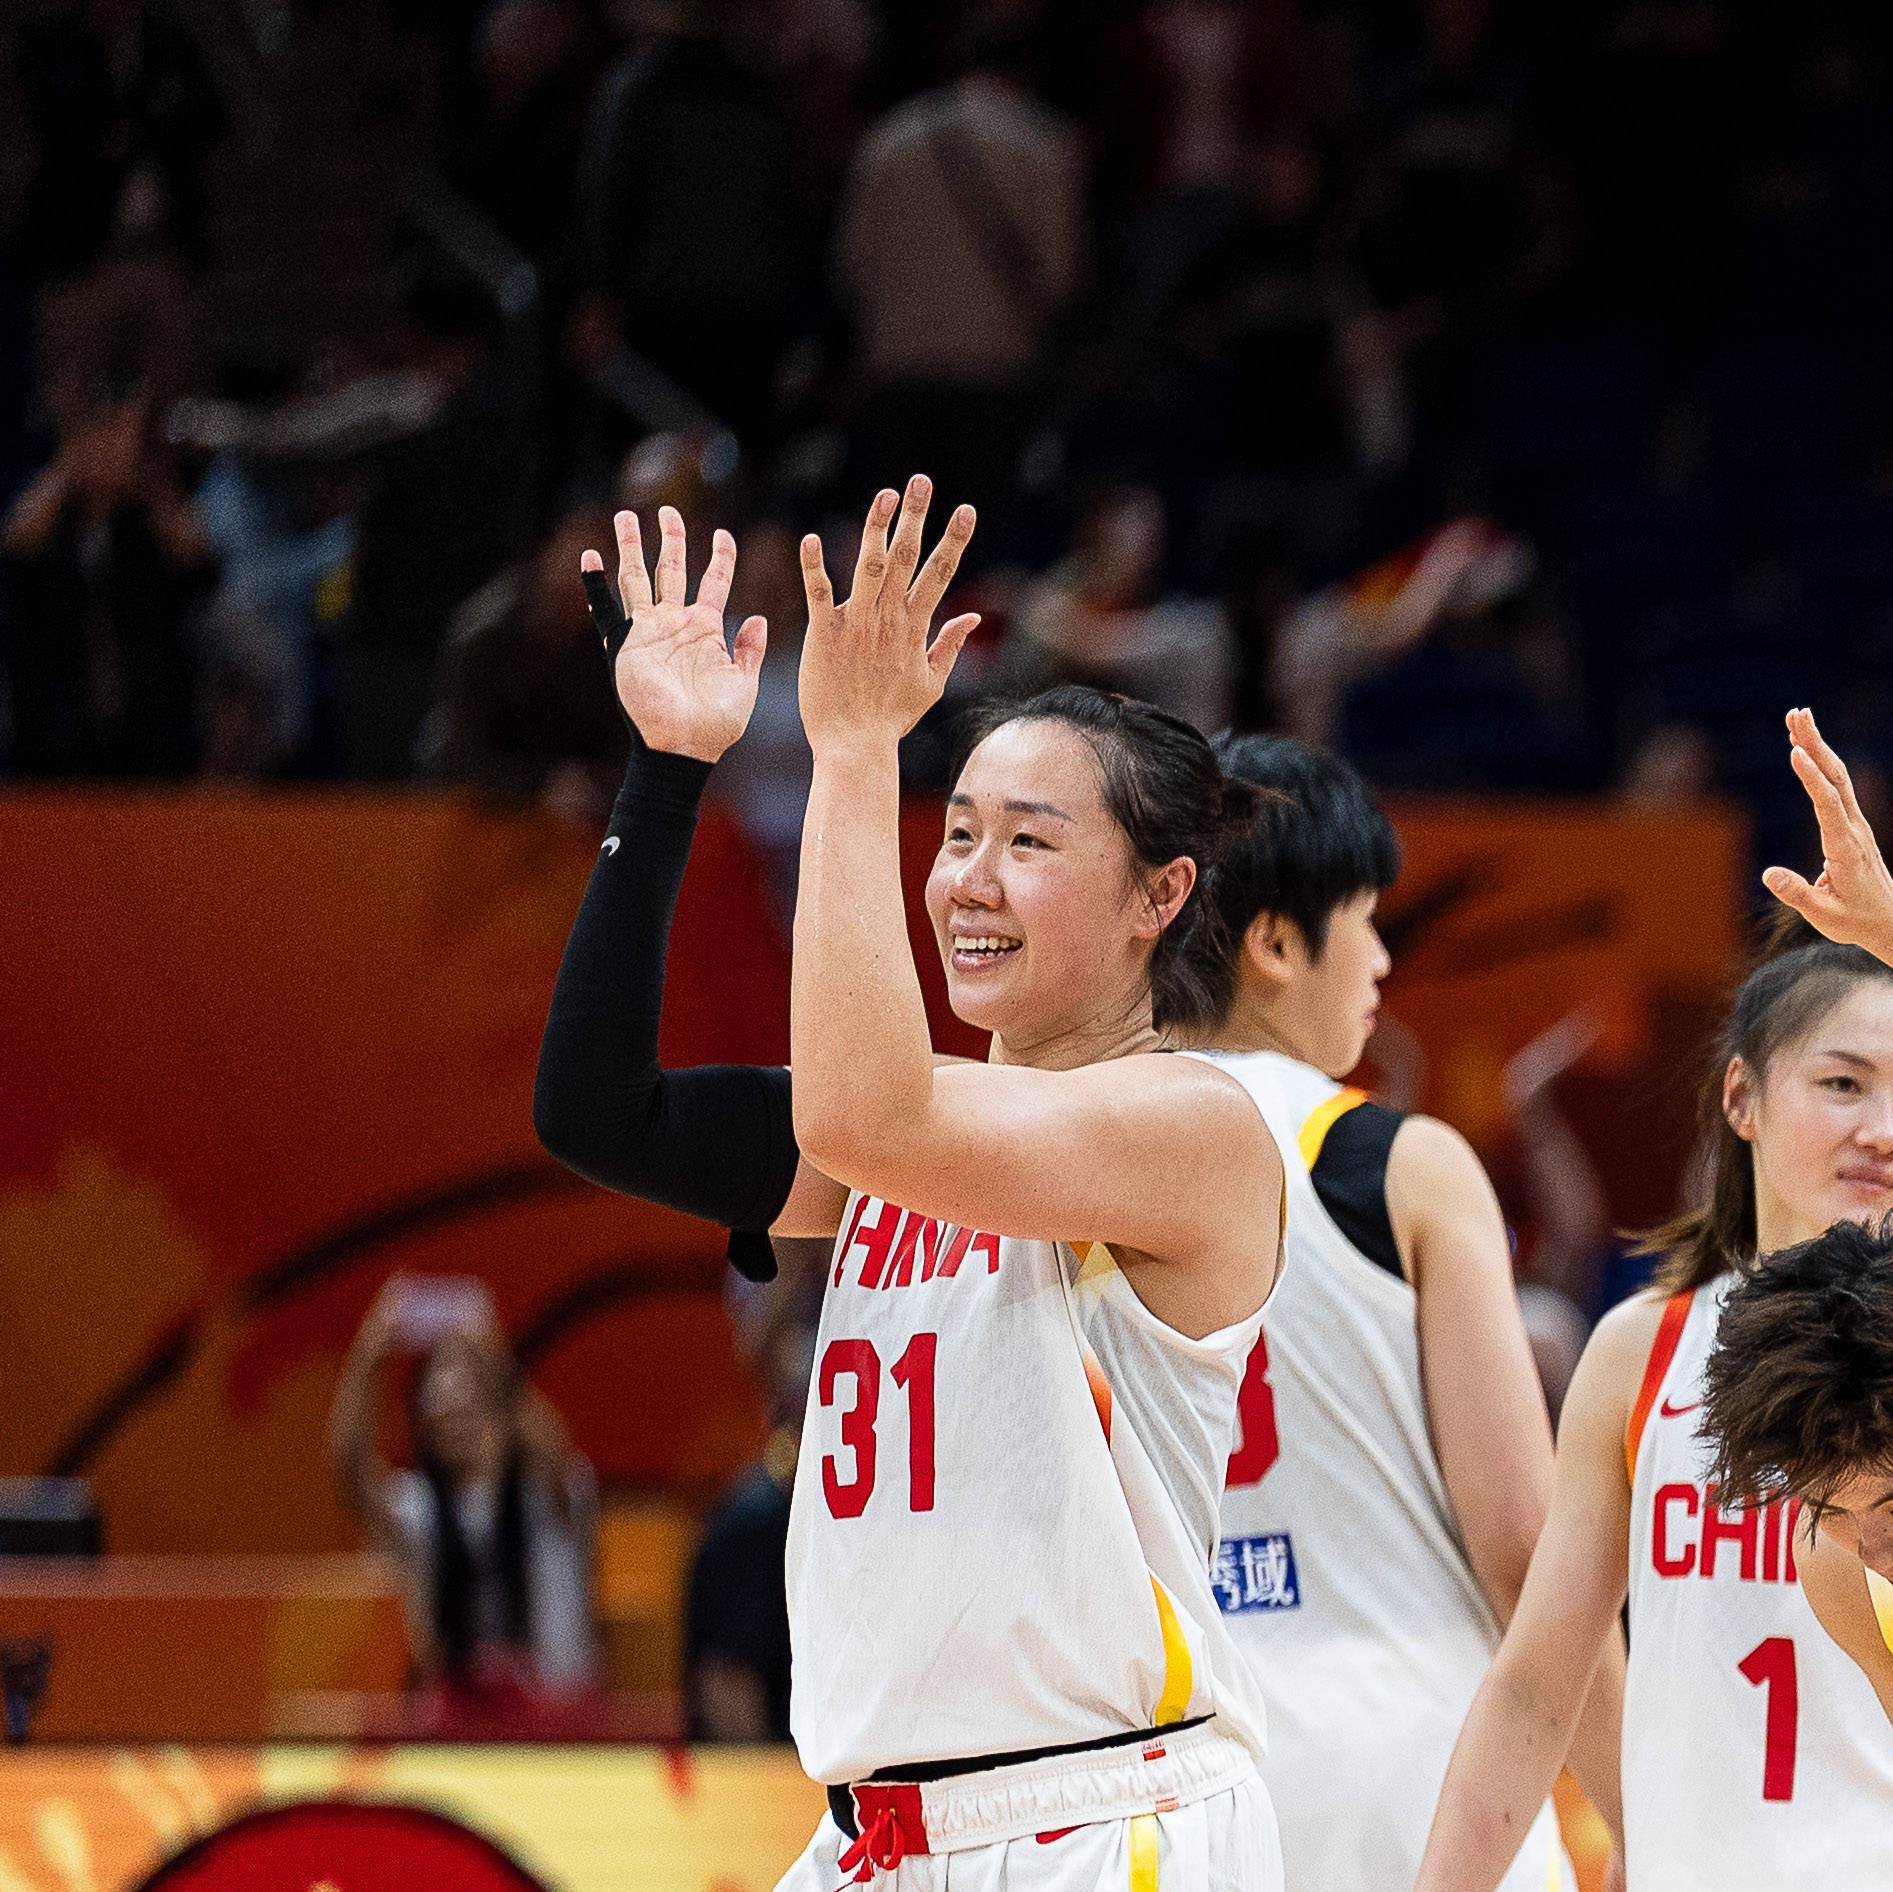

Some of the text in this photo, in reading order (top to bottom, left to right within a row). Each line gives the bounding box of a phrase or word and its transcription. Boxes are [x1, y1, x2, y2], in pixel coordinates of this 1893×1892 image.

[835, 1194, 1000, 1291] HINA
[819, 1333, 937, 1519] 31
[1738, 1637, 1799, 1802] 1
